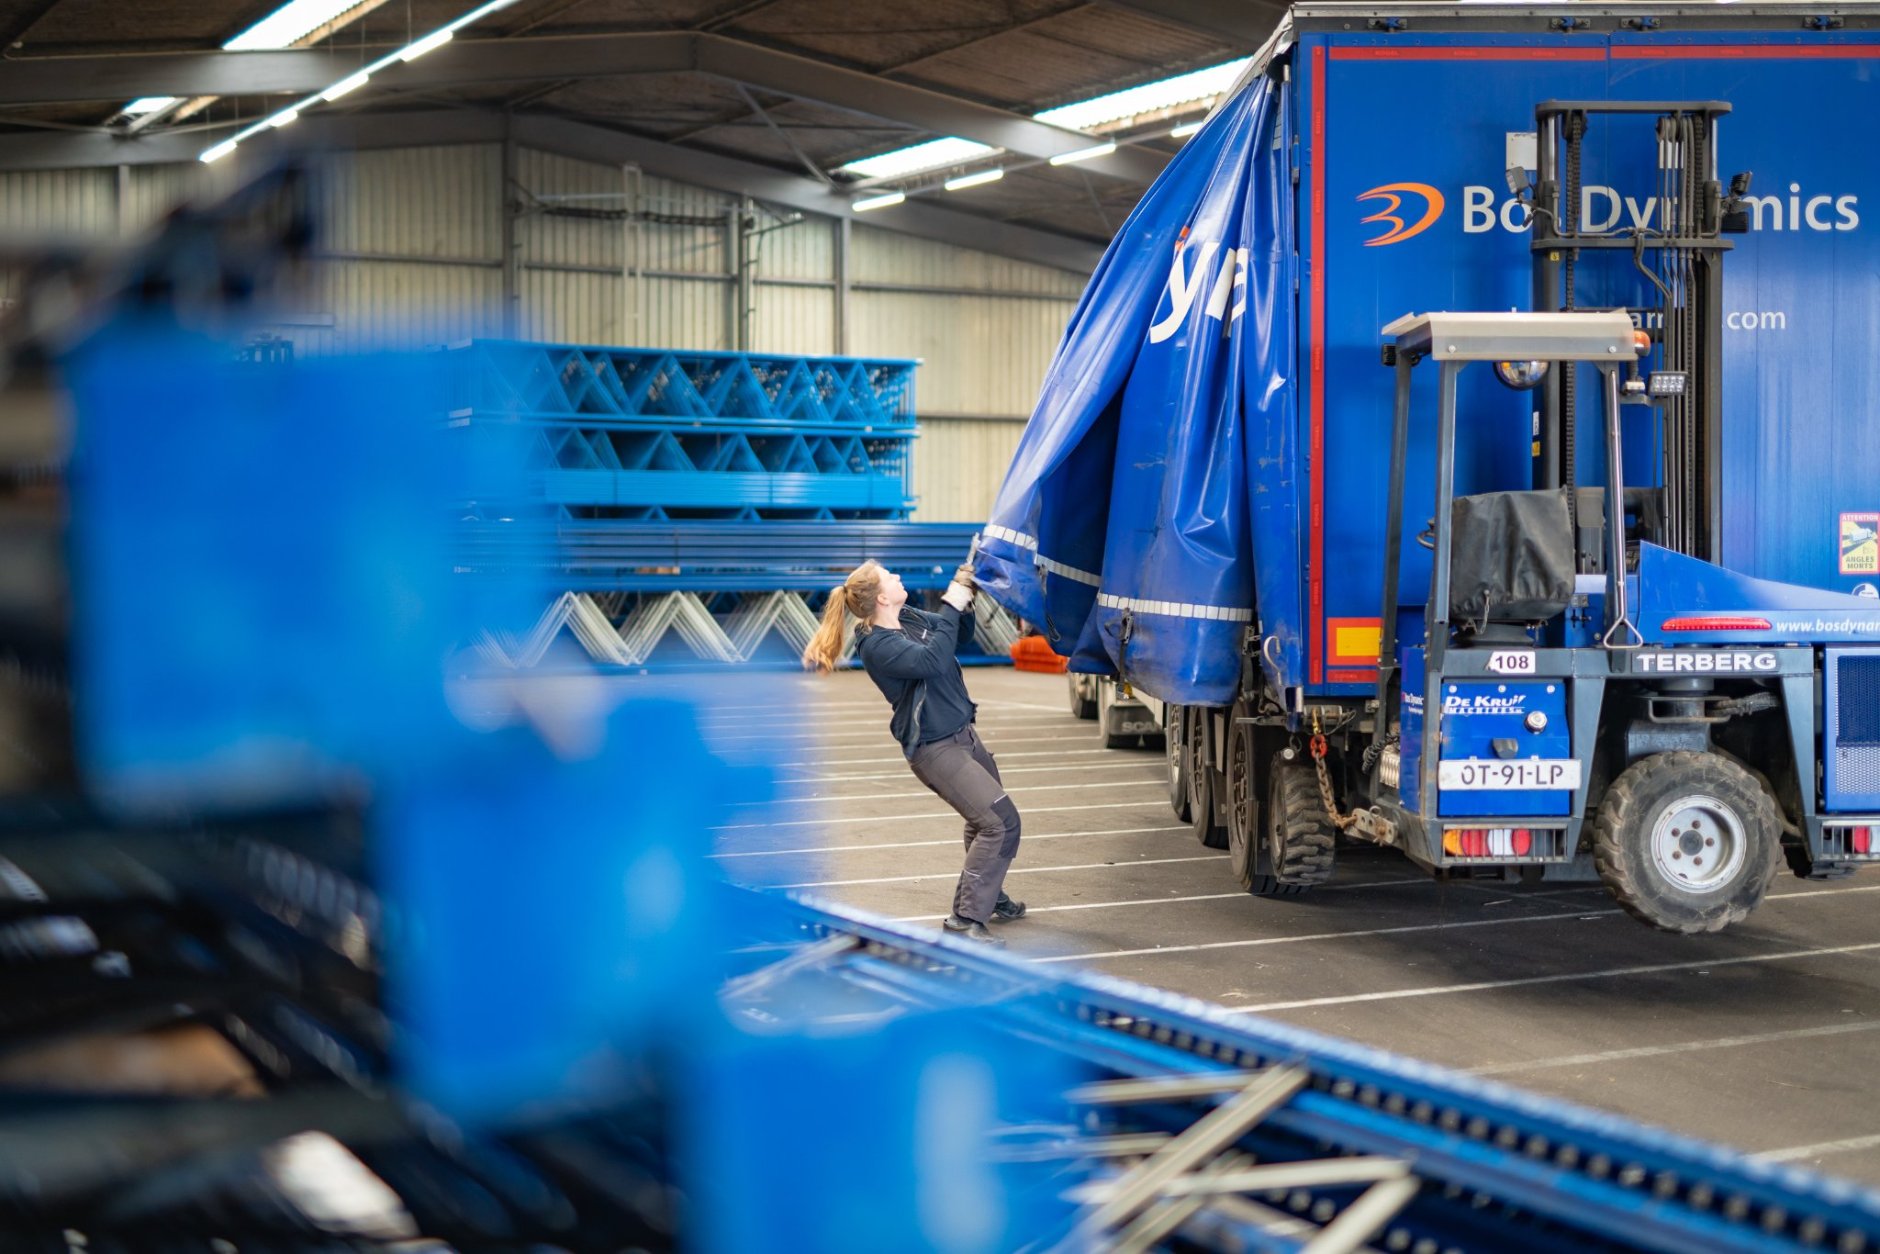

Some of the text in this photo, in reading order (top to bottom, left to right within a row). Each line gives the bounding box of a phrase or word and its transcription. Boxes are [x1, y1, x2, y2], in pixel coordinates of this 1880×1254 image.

[1463, 183, 1859, 234] Bo Dymics
[1495, 655, 1529, 669] 108
[1636, 653, 1777, 671] TERBERG
[1122, 721, 1155, 733] SCA
[1461, 764, 1564, 785] OT-91-LP
